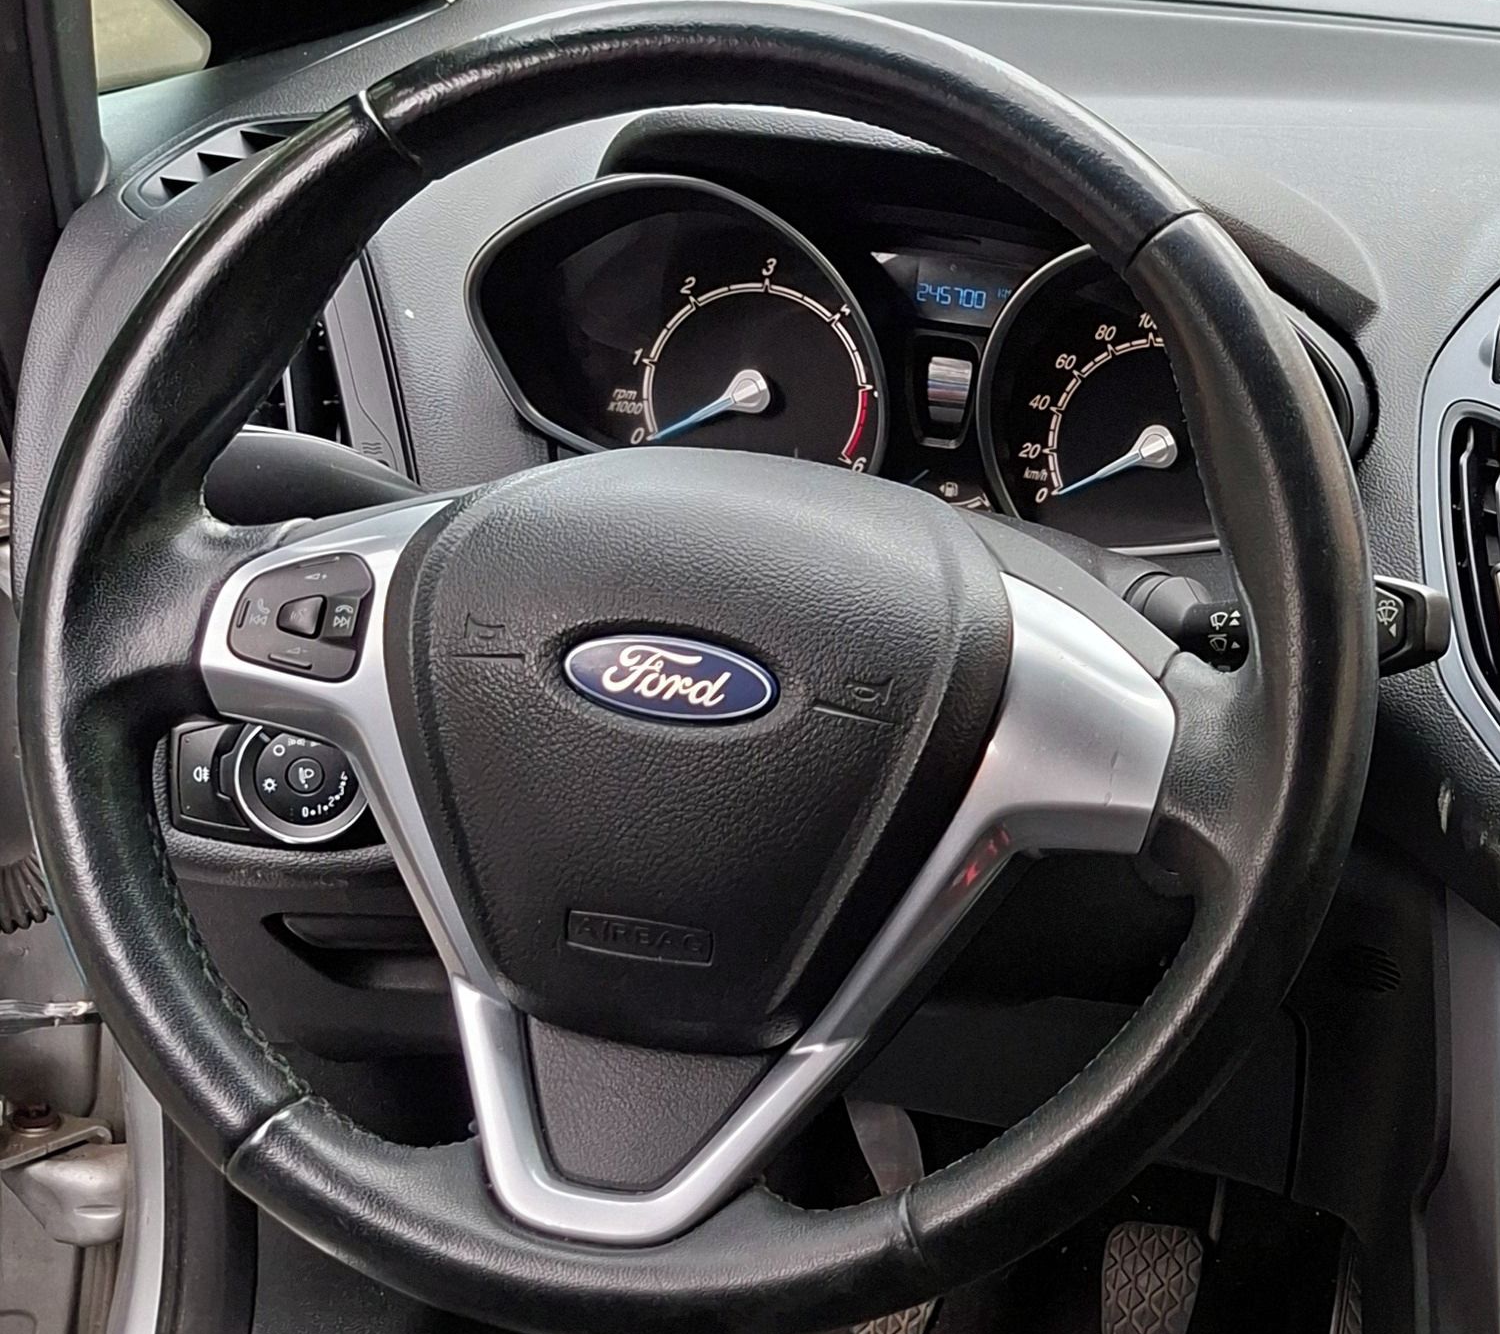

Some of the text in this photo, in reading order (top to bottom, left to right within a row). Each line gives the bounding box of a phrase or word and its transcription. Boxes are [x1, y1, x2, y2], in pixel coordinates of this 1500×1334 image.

[762, 257, 778, 276] 3
[680, 276, 696, 294] 2
[916, 282, 987, 309] 245700
[1095, 323, 1118, 342] 80
[632, 348, 643, 365] 1
[1055, 354, 1076, 369] 60
[612, 388, 638, 402] rpm
[1029, 395, 1051, 411] 40
[607, 400, 643, 415] x1000
[630, 427, 645, 445] 0
[1018, 443, 1042, 459] 20
[852, 456, 868, 474] 6
[1022, 468, 1048, 482] km/h
[1034, 487, 1048, 503] 0
[600, 643, 725, 710] Ford
[302, 806, 309, 818] 0
[328, 795, 336, 807] 2
[574, 916, 704, 953] AIRBAG
